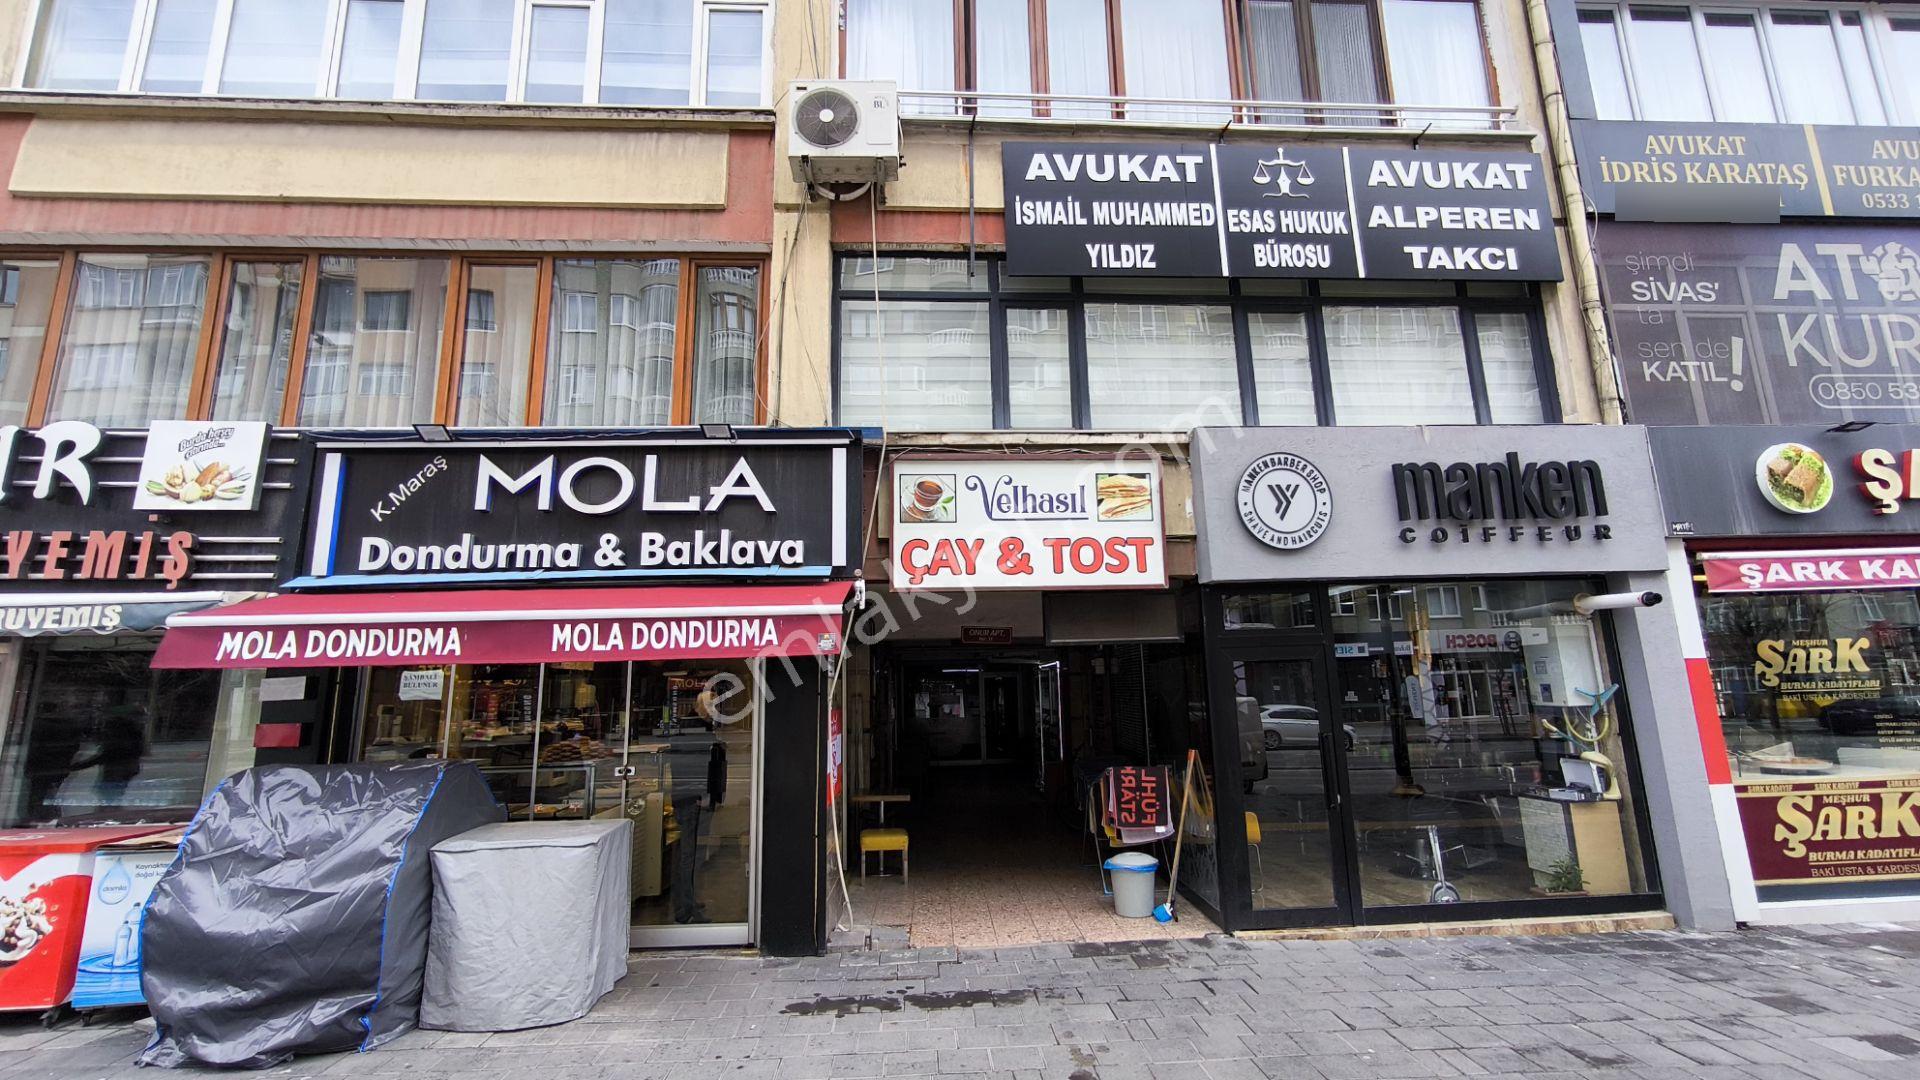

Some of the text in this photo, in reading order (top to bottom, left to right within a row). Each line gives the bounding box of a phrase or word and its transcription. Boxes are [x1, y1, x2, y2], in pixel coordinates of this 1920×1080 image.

[1645, 135, 1746, 155] AVUKAT
[1024, 153, 1204, 183] AVUKAT
[1367, 159, 1533, 191] AVUKAT
[1600, 156, 1809, 191] İDRİS KARATAŞ
[1015, 195, 1216, 227] İSMAİL MUHAMMED
[1862, 193, 1910, 209] 0533
[1227, 209, 1348, 235] ESAS HUKUK
[1367, 205, 1542, 232] ALPEREN
[1085, 243, 1157, 269] YILDIZ
[1253, 240, 1331, 269] BÜROSU
[1403, 245, 1519, 271] TAKCI
[1625, 251, 1696, 275] şimdi
[1631, 277, 1719, 302] SİVAS'
[1638, 305, 1663, 325] ta
[1638, 338, 1730, 359] sen de
[1818, 382, 1882, 400] 0850
[369, 452, 448, 523] K.Maraş
[474, 453, 778, 516] MOLA
[1241, 456, 1327, 494] MANKEN BARBER SHOP
[1391, 451, 1609, 522] manken
[965, 474, 1089, 520] Velhasıl
[1243, 510, 1328, 546] SHAVE AND HAIRCUTS
[6, 514, 198, 590] YEMİŞ
[359, 529, 805, 572] Dondurma & Baklava
[901, 536, 1155, 585] ÇAY & TOST
[1739, 558, 1920, 589] ŞARK KA
[215, 627, 461, 662] MOLA DONDURMA
[551, 619, 779, 652] MOLA DONDURMA
[1754, 637, 1870, 687] ŞARK
[1781, 682, 1816, 690] BURMA
[1823, 794, 1870, 804] MEŞHUR
[1774, 793, 1920, 858] ŞARK
[1808, 848, 1920, 862] BURMA KADAYIFL
[1811, 867, 1835, 877] BAKİ
[1837, 866, 1864, 876] USTA
[1866, 866, 1876, 875] &
